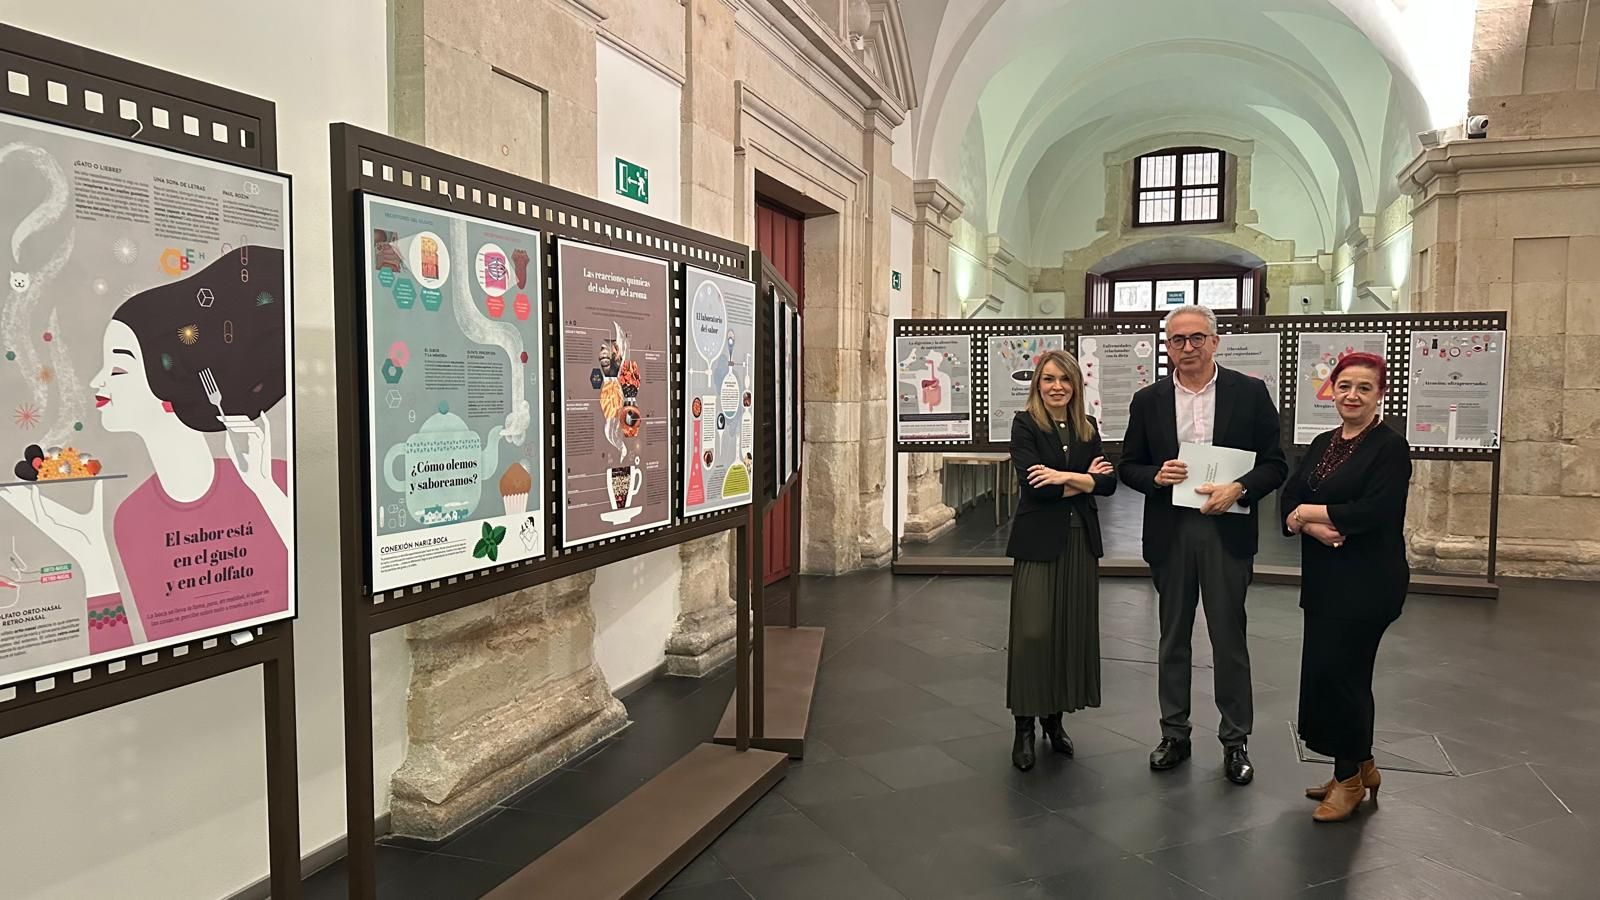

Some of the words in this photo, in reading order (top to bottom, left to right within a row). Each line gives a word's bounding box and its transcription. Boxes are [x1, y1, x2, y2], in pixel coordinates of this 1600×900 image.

[74, 160, 92, 168] ¿GATO
[100, 165, 122, 173] LIEBRE?
[188, 183, 206, 191] LETRAS
[583, 268, 594, 278] Las
[595, 272, 626, 283] reacciones
[588, 282, 598, 292] del
[599, 285, 615, 294] sabor
[615, 289, 619, 298] y
[620, 288, 629, 297] del
[630, 292, 647, 300] aroma
[696, 312, 700, 320] El
[701, 313, 722, 324] laboratorio
[708, 325, 718, 334] sabor
[410, 460, 445, 477] ¿Cómo
[446, 458, 478, 470] olemos
[409, 483, 417, 494] y
[417, 474, 478, 490] saboreamos?
[165, 531, 182, 548] El
[183, 527, 225, 545] sabor
[226, 522, 254, 540] está
[380, 541, 413, 554] CONEXIÓN
[415, 538, 432, 548] NARIZ
[433, 536, 448, 544] BOCA
[173, 554, 191, 569] en
[192, 549, 208, 565] el
[210, 543, 247, 567] gusto
[165, 580, 174, 596] y
[178, 575, 196, 590] en
[198, 571, 212, 586] el
[214, 566, 254, 584] olfato
[23, 604, 62, 616] ORTO-NASAL
[2, 614, 45, 627] RETRO-NASAL
